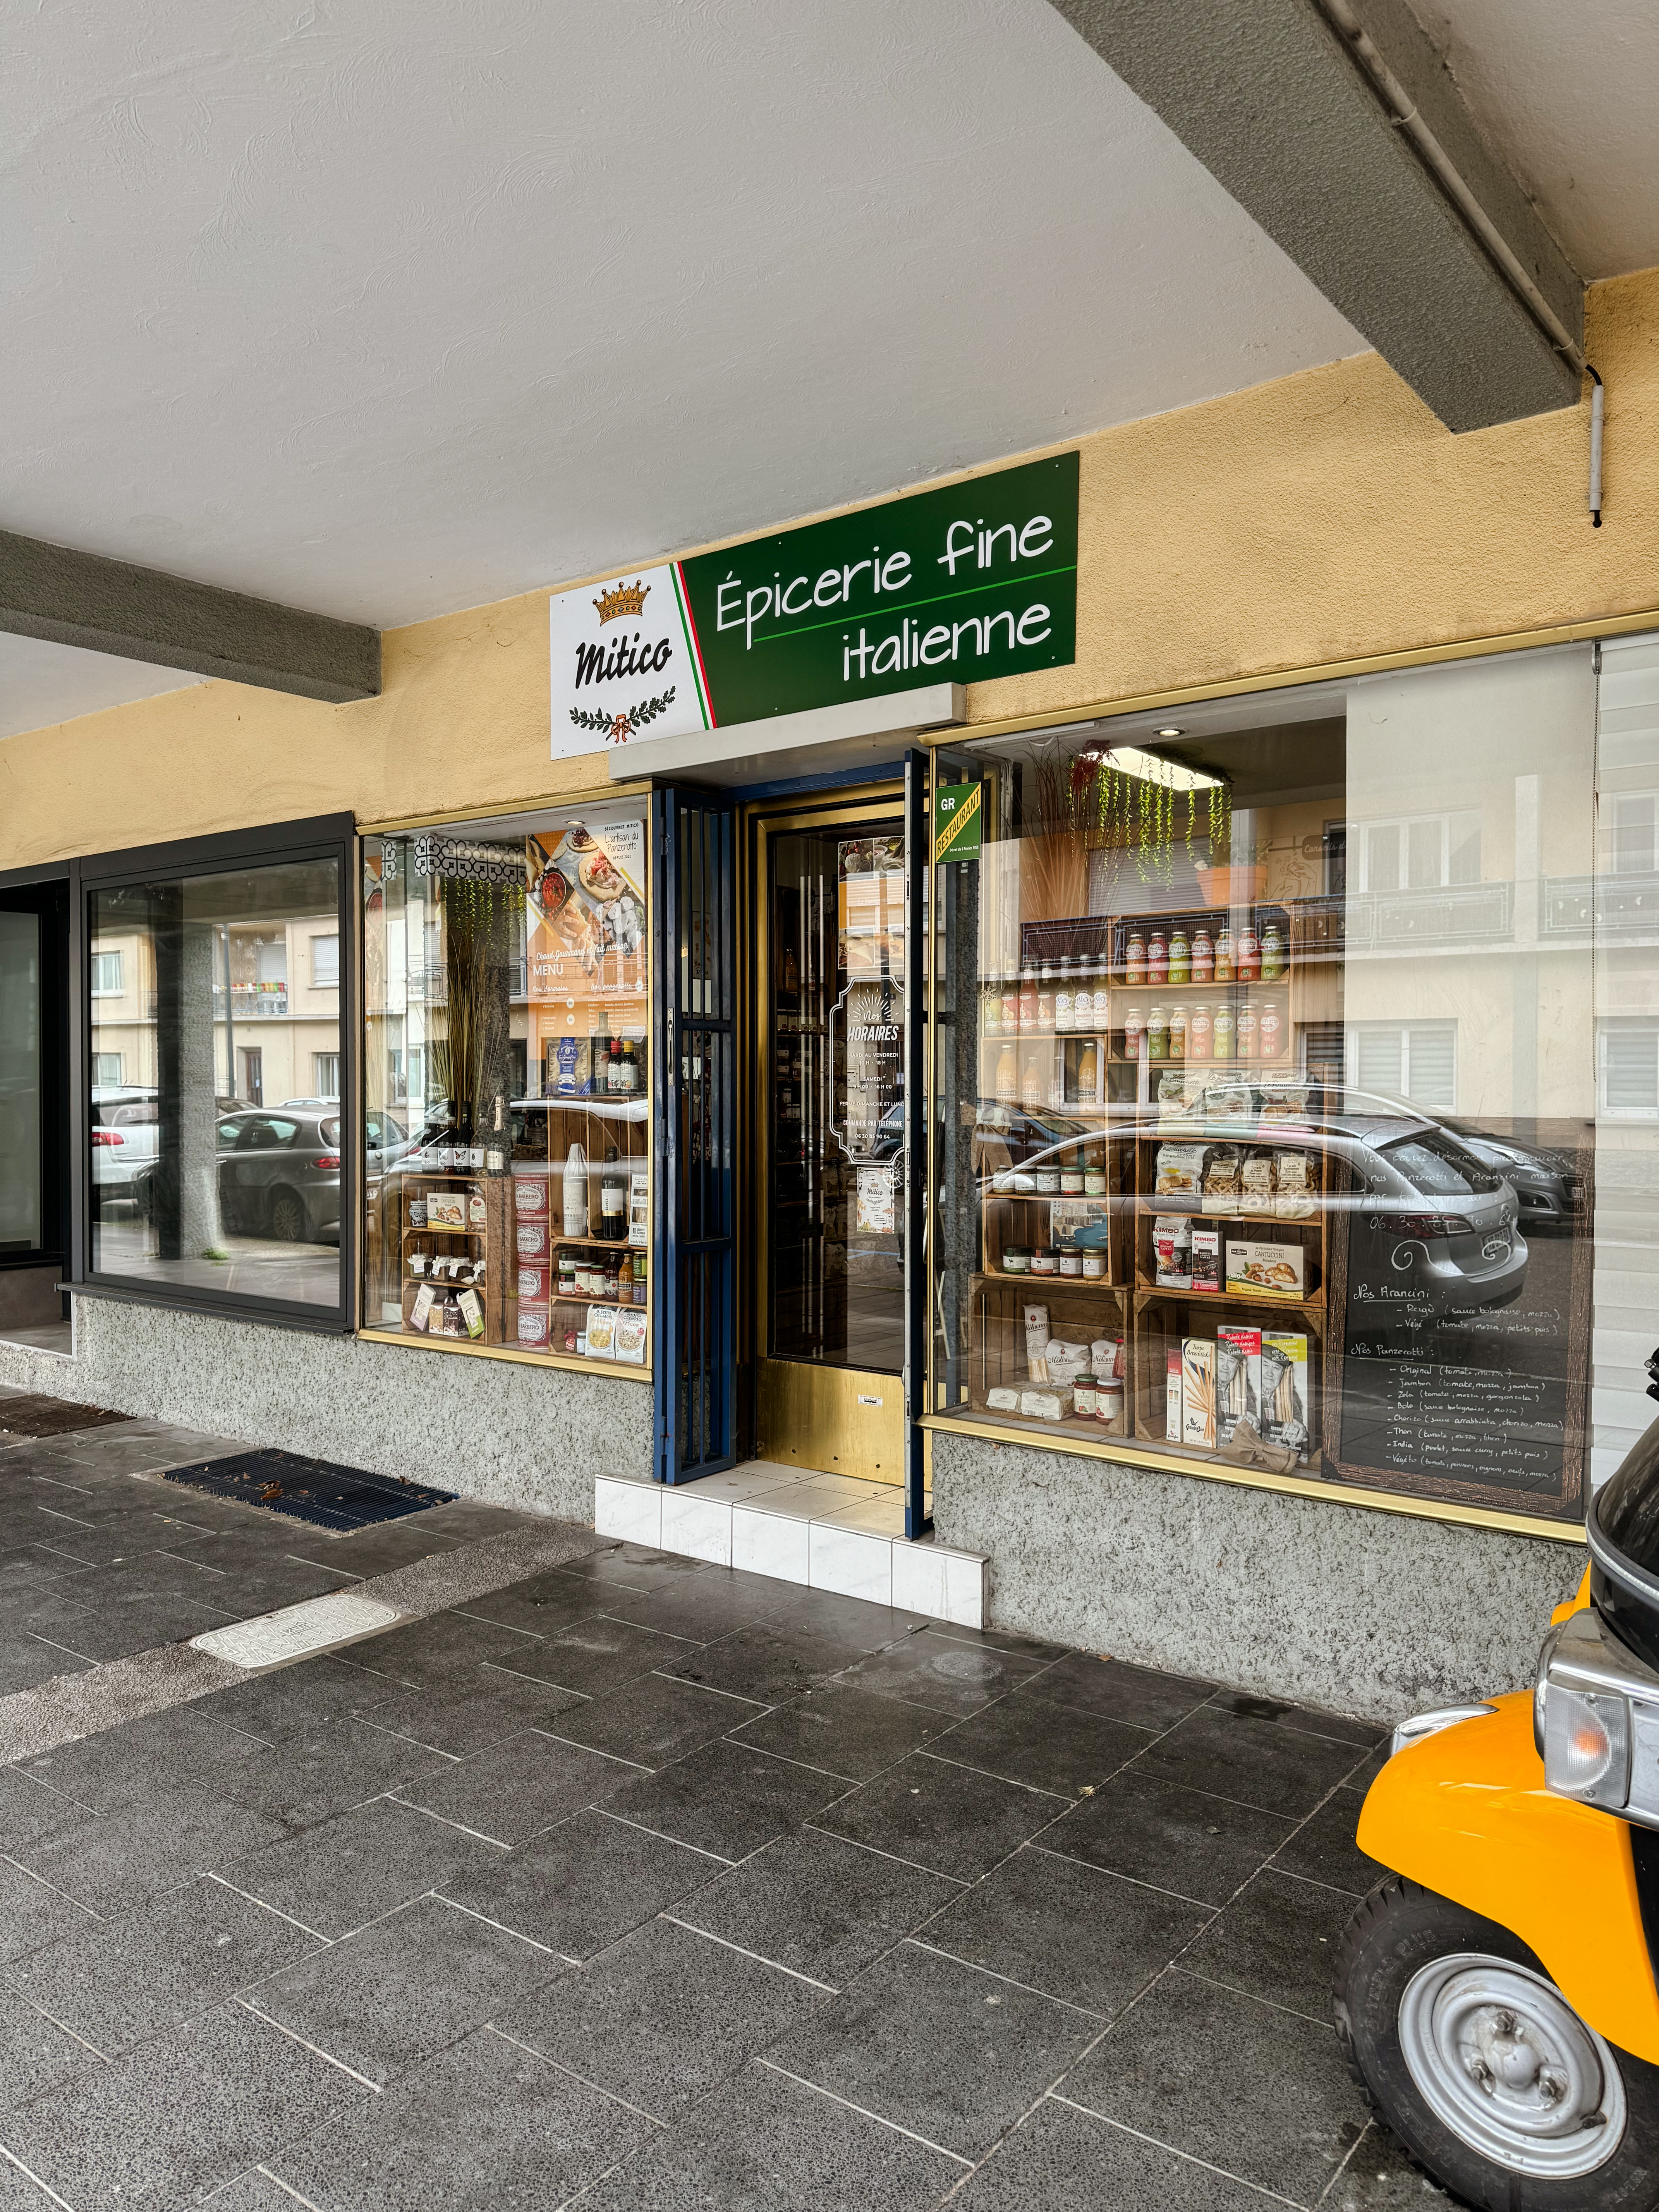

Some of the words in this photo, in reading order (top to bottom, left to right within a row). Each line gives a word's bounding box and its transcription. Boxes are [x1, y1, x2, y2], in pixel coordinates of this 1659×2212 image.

[716, 570, 912, 650] Épicerie
[938, 515, 1054, 576] fine
[843, 604, 1052, 681] italienne
[575, 633, 673, 689] Mitico
[941, 798, 955, 811] GR
[937, 789, 979, 857] RESTAURANT
[605, 833, 629, 843] L'artisan
[632, 831, 639, 840] du
[607, 841, 637, 852] Panzerotto
[594, 943, 605, 954] fait
[606, 942, 629, 951] maison
[533, 963, 563, 976] MENU
[864, 1010, 882, 1021] Nos
[847, 1025, 899, 1041] HORAIRES
[878, 1119, 903, 1127] TÉLÉPHONE
[1397, 1171, 1448, 1182] Panzerotti
[1453, 1171, 1465, 1181] et
[1354, 1283, 1374, 1299] Nos
[1380, 1286, 1430, 1298] Arancini
[1351, 1343, 1371, 1355] Nos
[1376, 1344, 1424, 1356] Panzerotti
[1400, 1365, 1432, 1377] Original
[1399, 1378, 1431, 1388] Jambon
[1398, 1391, 1414, 1399] Zola
[1501, 1448, 1522, 1457] petits
